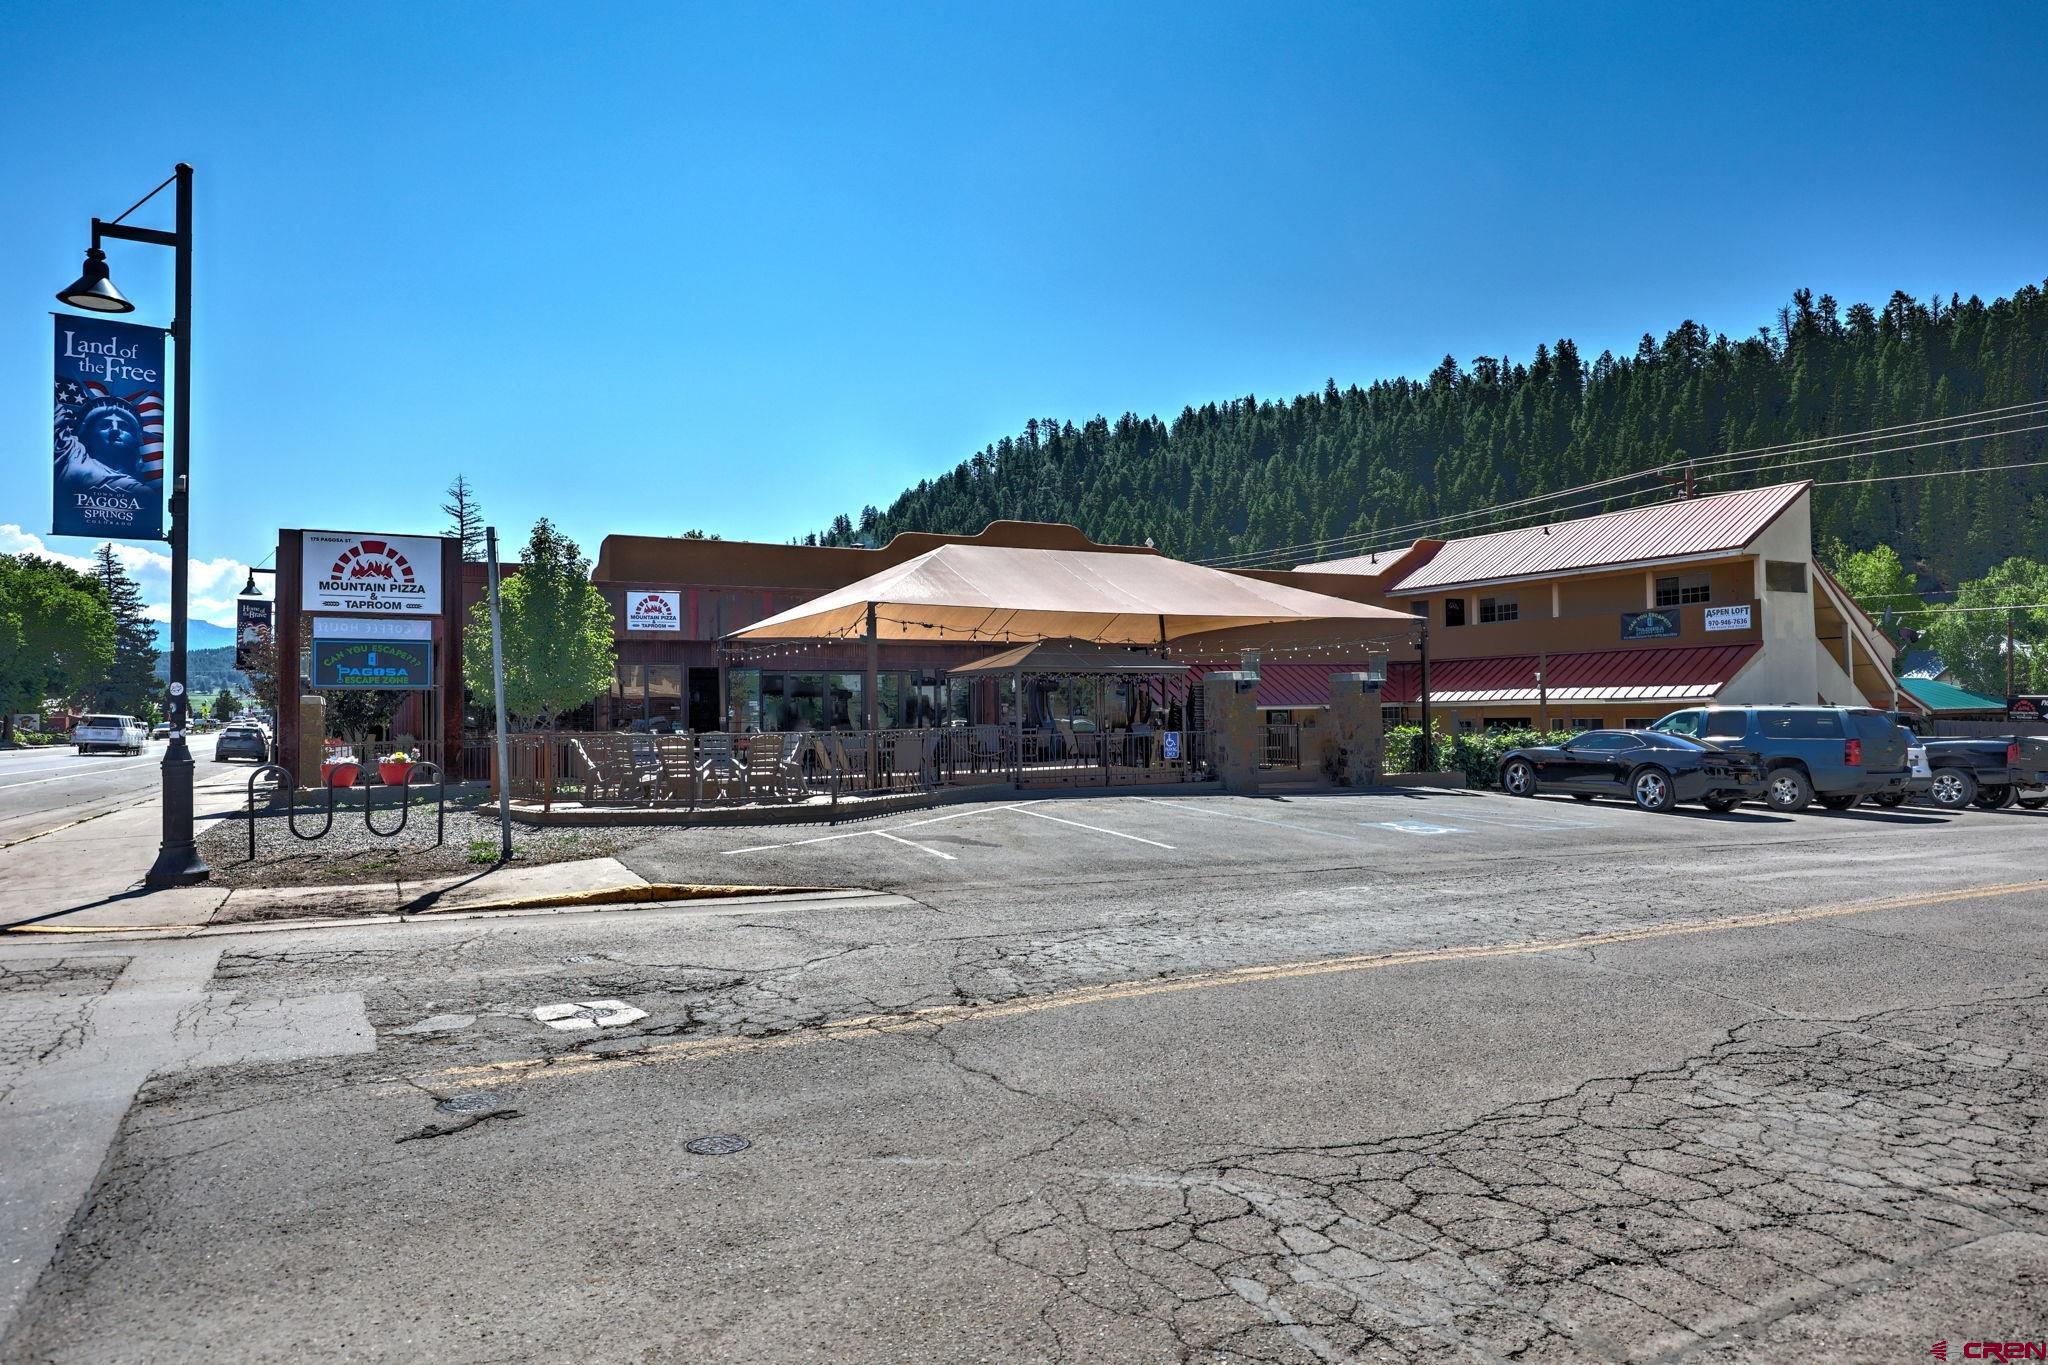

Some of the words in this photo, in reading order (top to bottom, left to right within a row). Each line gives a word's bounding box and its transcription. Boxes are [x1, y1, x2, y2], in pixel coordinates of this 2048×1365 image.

[64, 331, 117, 358] Land
[120, 344, 138, 359] of
[79, 357, 104, 374] the
[104, 356, 157, 382] Free
[74, 493, 144, 510] PAGOSA
[84, 509, 133, 521] SPRINGS
[319, 581, 386, 592] MOUNTAIN
[389, 583, 426, 594] PIZZA
[369, 592, 378, 601] &
[344, 600, 402, 610] TAPROOM
[1706, 608, 1730, 618] ASPEN
[1731, 606, 1749, 616] LOFT
[323, 650, 345, 667] CAN
[346, 644, 368, 655] YOU
[338, 667, 409, 676] PAGOSA
[344, 676, 380, 684] ESCAPE
[382, 676, 409, 684] ZONE
